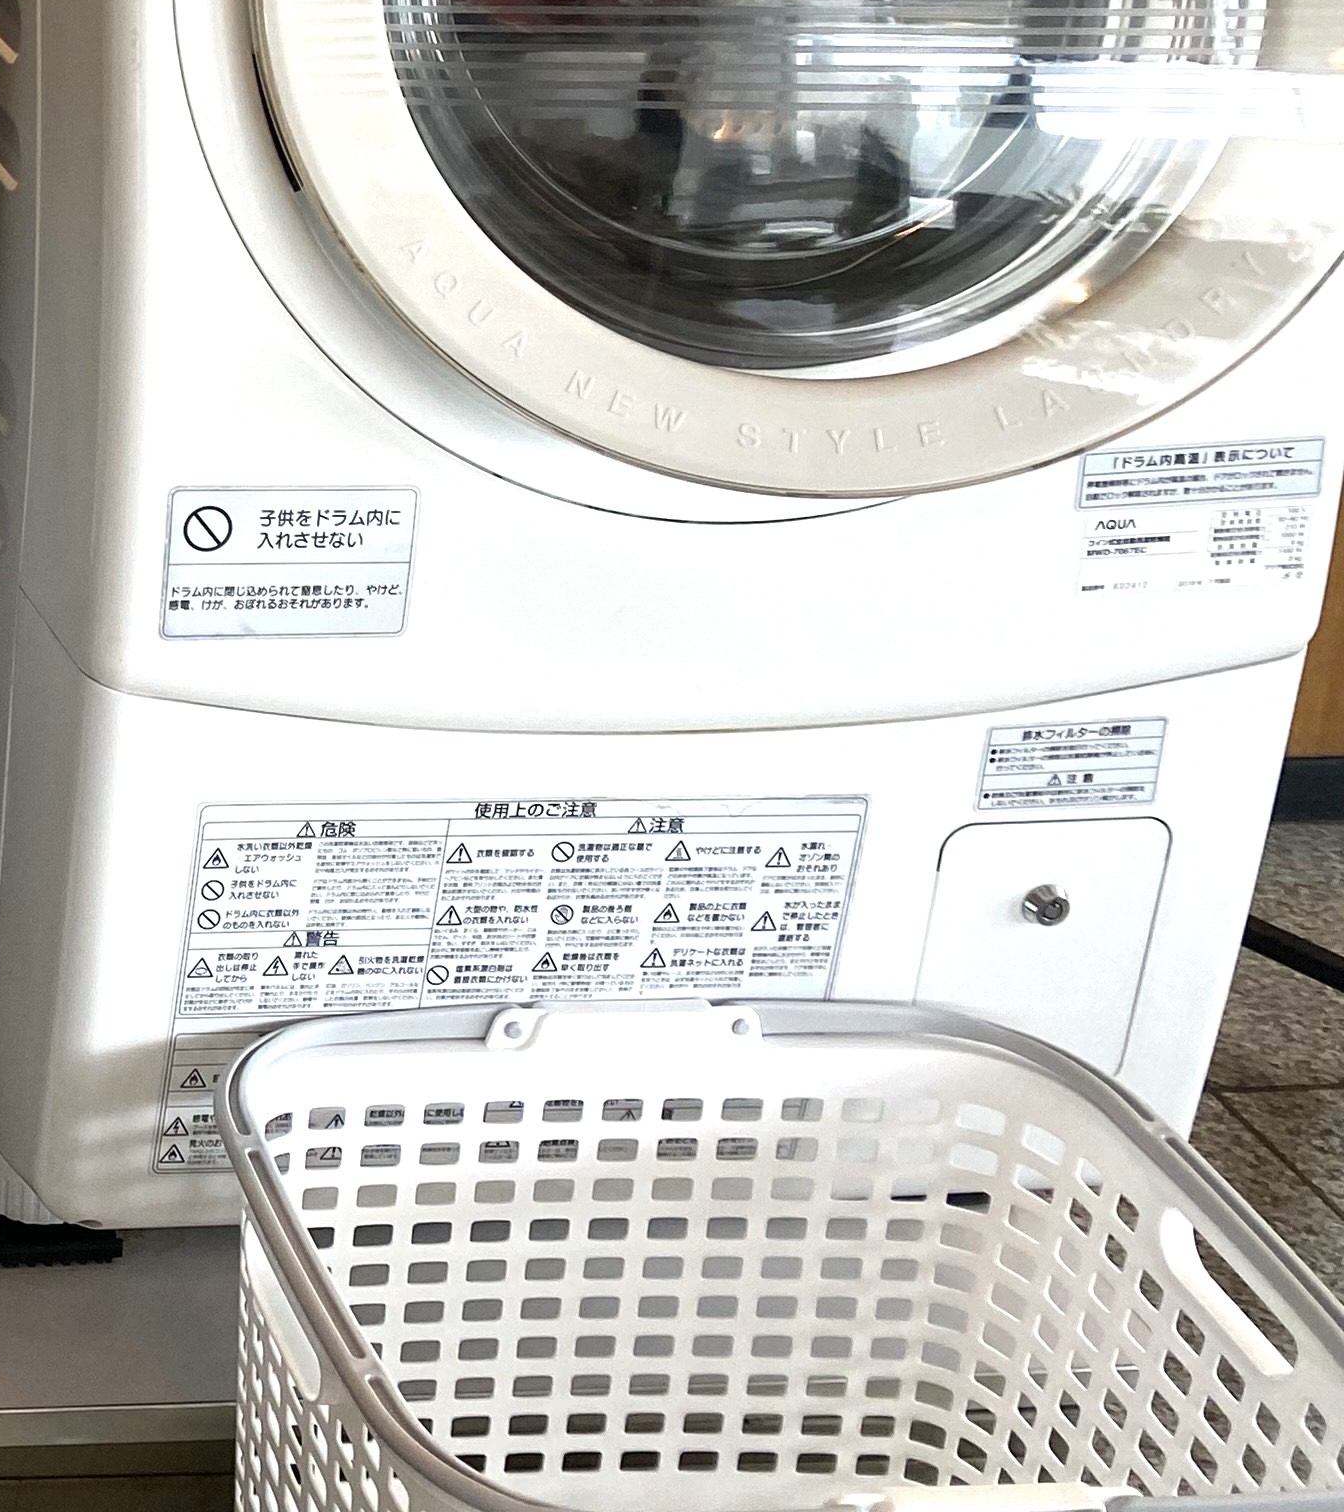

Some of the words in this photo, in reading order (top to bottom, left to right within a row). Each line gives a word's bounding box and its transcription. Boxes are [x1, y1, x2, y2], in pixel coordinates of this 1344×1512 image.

[400, 237, 531, 360] AQUA
[568, 374, 693, 432] NEW
[260, 510, 401, 527] 子供をドラム内に
[1095, 520, 1137, 530] AQUA
[257, 532, 363, 549] 入れさせない
[475, 802, 597, 819] 使用上のご注意
[321, 821, 356, 837] 危険
[649, 818, 685, 833] 注意
